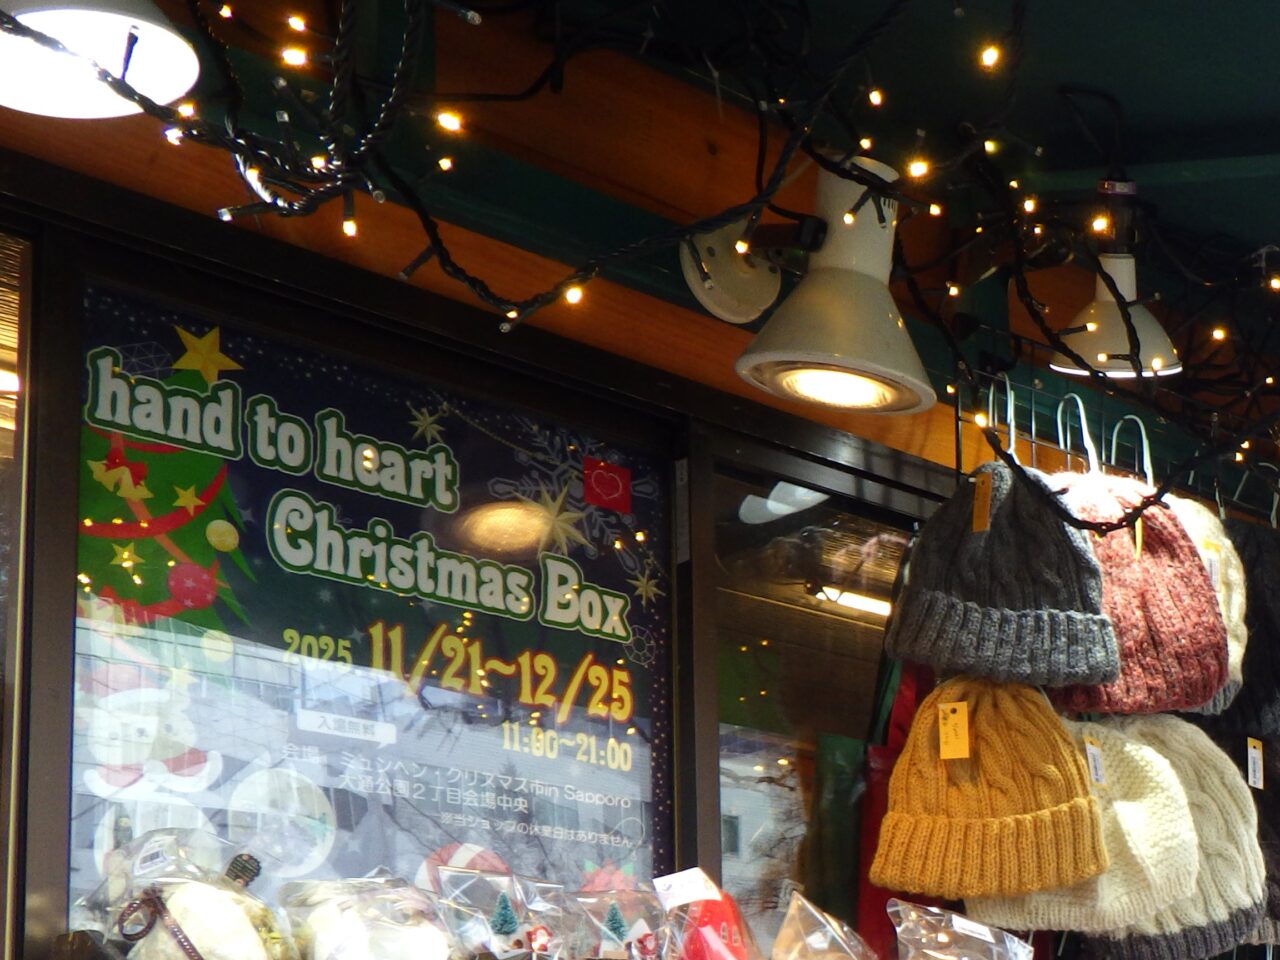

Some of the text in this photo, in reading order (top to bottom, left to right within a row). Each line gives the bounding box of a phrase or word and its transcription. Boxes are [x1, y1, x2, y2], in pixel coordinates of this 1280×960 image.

[88, 348, 457, 508] hand to heart
[270, 492, 630, 640] Christmas Box
[564, 785, 631, 809] Sapporo
